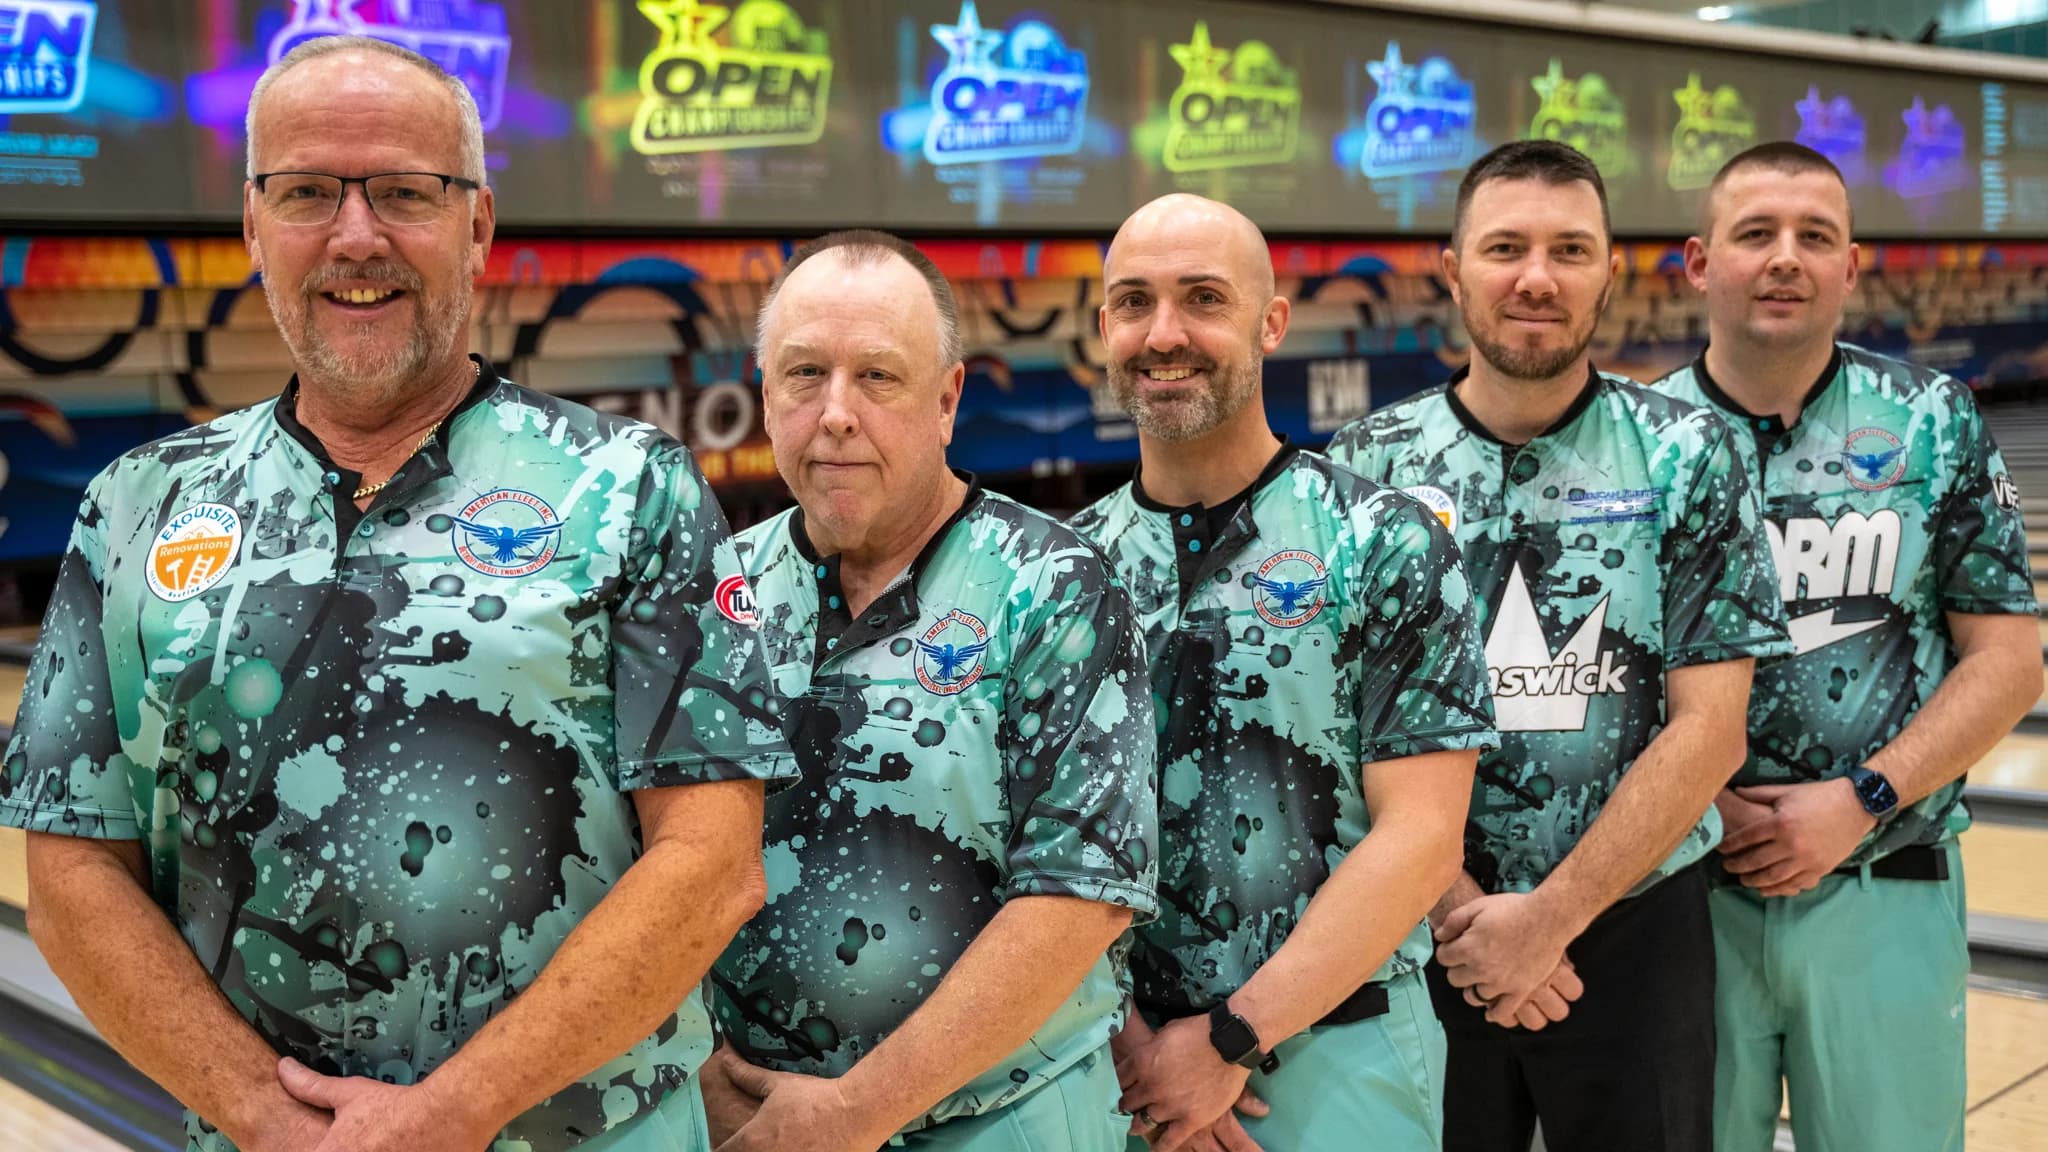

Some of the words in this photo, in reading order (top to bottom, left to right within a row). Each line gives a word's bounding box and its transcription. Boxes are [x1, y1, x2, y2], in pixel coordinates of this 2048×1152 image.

[652, 58, 820, 108] OPEN
[592, 380, 755, 449] NO
[464, 491, 509, 518] AMERICAN
[512, 492, 540, 507] FLEET
[539, 505, 553, 522] INC.
[161, 505, 237, 541] EXQUISITE
[159, 540, 230, 557] Renovations
[1260, 553, 1293, 575] AMERICAN
[958, 614, 979, 627] FLEET
